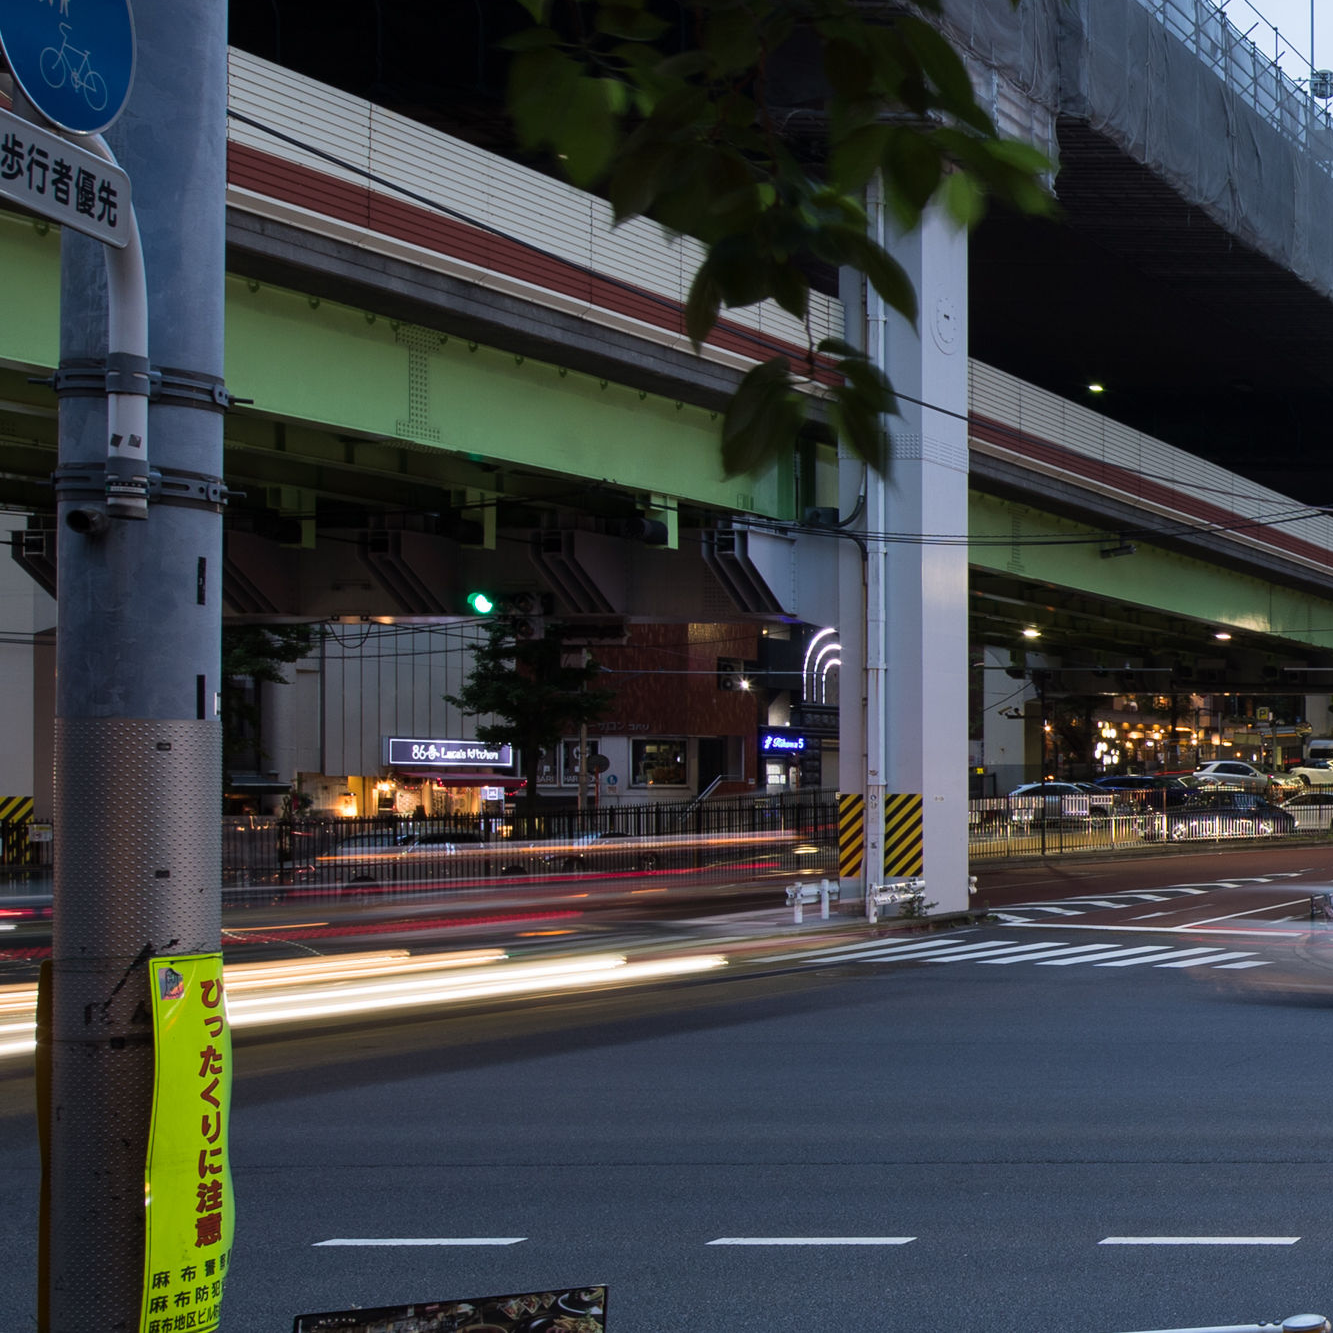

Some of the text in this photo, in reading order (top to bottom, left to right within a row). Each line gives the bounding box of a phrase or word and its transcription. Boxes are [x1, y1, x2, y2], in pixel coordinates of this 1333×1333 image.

[1, 133, 118, 227] 歩行者優先
[195, 978, 223, 1248] ひったくりに注意
